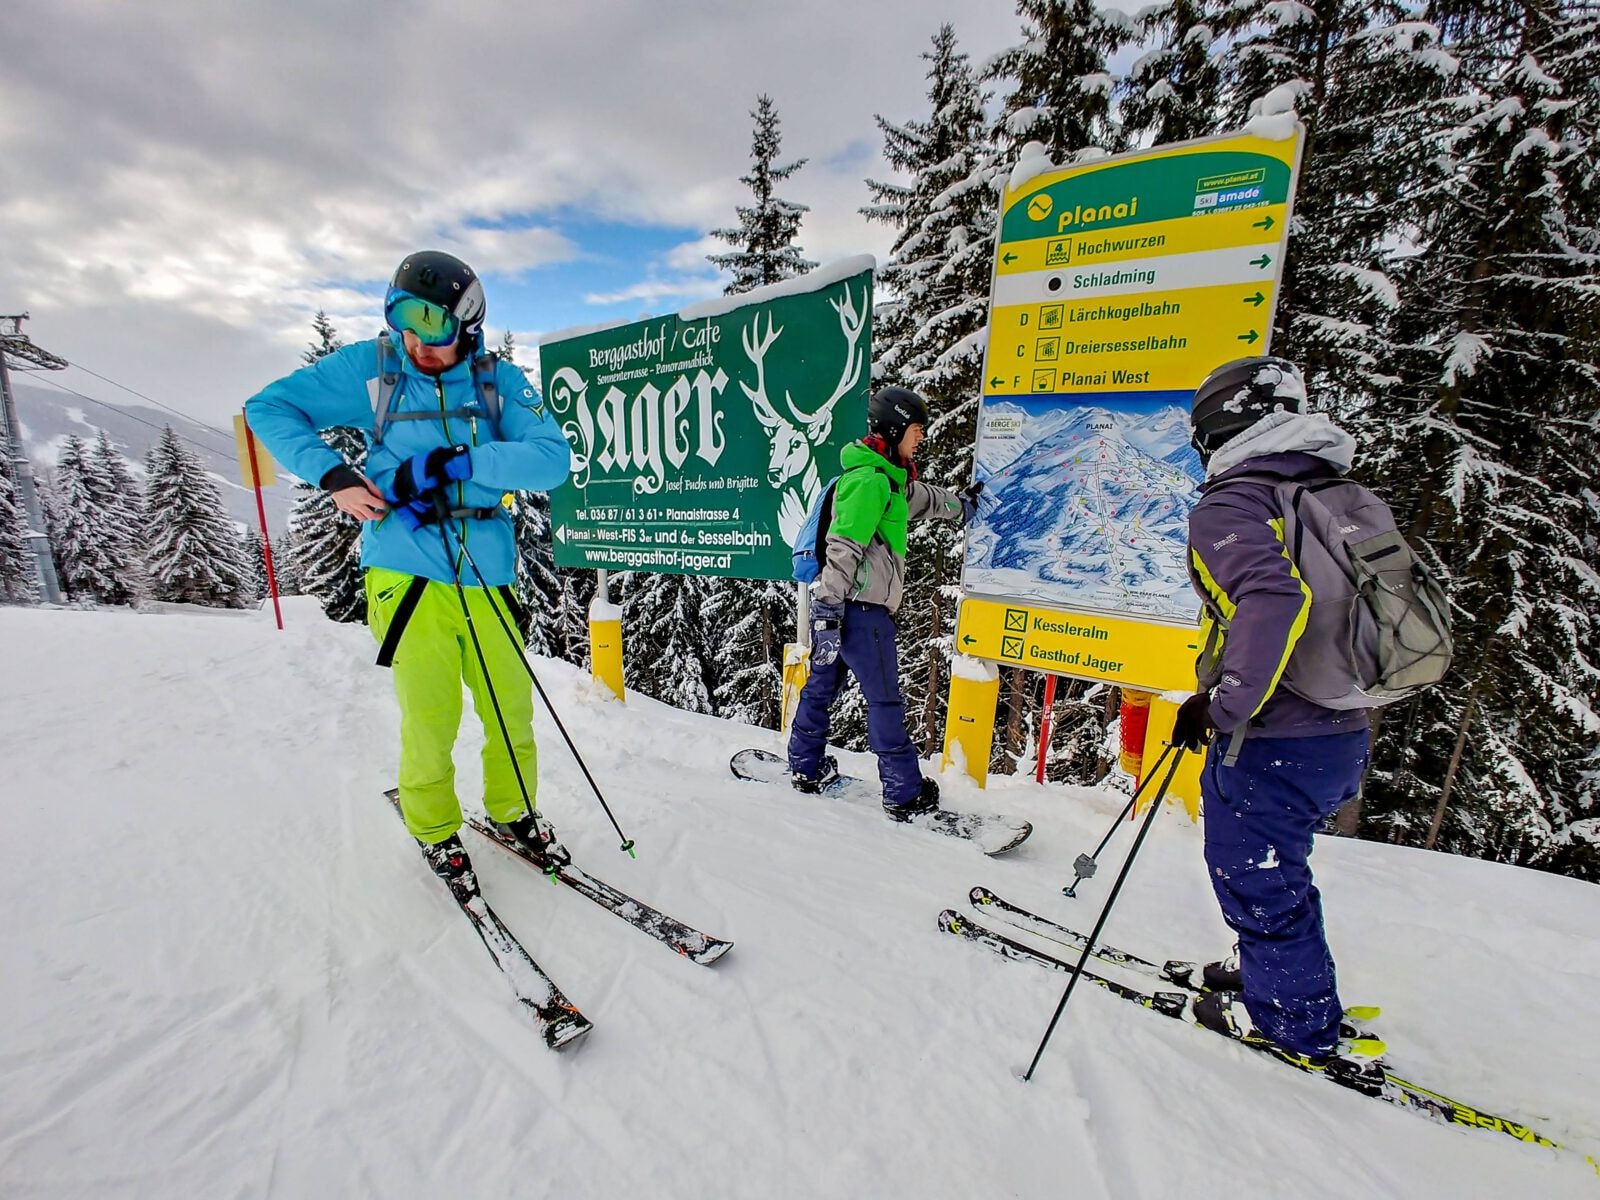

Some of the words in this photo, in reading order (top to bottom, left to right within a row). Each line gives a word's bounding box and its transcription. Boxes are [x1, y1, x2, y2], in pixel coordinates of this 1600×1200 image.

[1203, 172, 1259, 187] www.planai.at
[1057, 196, 1138, 233] planai
[1055, 243, 1064, 252] 4
[1077, 235, 1165, 256] Hochwurzen
[1073, 268, 1156, 289] Schladming
[1020, 313, 1029, 326] D
[1069, 301, 1181, 322] Lärchkogelbahn
[588, 323, 667, 371] Berggasthof
[682, 317, 721, 353] Cafe
[1016, 344, 1025, 358] C
[1065, 335, 1187, 354] Dreiersesselbahn
[597, 367, 649, 385] Sonnenterrasse
[655, 349, 714, 374] Panoramablick
[1013, 375, 1021, 388] F
[1061, 371, 1107, 386] Planai
[1112, 370, 1150, 385] West
[550, 366, 730, 494] Jager
[665, 475, 684, 495] Josef
[684, 474, 707, 492] Fuchs
[708, 476, 725, 490] und
[726, 475, 759, 492] Brigitte
[575, 509, 589, 521] Tel.
[590, 509, 606, 520] 036
[607, 509, 618, 520] 87
[625, 508, 635, 520] 61
[638, 508, 645, 520] 3
[666, 508, 730, 520] Planaistrasse
[732, 507, 740, 520] 4
[566, 529, 591, 540] Planai
[597, 528, 636, 542] West-FIS
[639, 528, 652, 543] 3er
[654, 529, 677, 543] und
[680, 530, 695, 544] 6er
[697, 530, 772, 546] Sesselbahn
[585, 548, 732, 571] www.berggasthof-jager.at
[1033, 617, 1108, 640] Kessleralm
[1030, 645, 1080, 665] Gasthof
[1082, 654, 1124, 673] Jager
